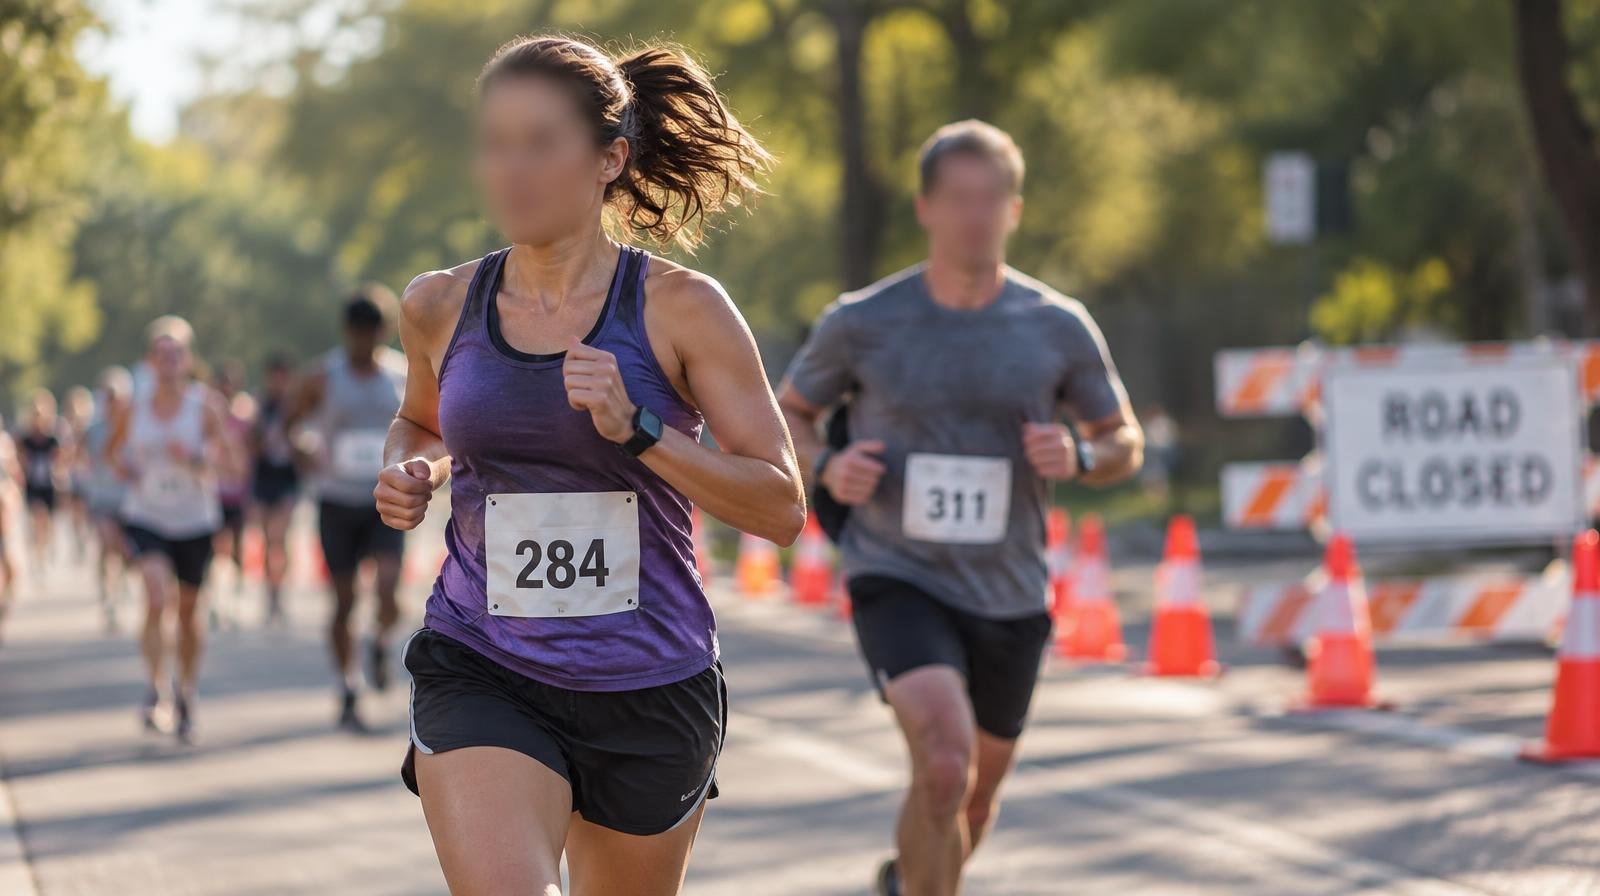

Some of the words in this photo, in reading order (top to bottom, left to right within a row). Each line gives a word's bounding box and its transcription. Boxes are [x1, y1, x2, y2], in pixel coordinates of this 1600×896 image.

[1382, 389, 1522, 441] ROAD
[926, 486, 987, 523] 311
[1357, 456, 1555, 511] CLOSED
[515, 538, 610, 590] 284
